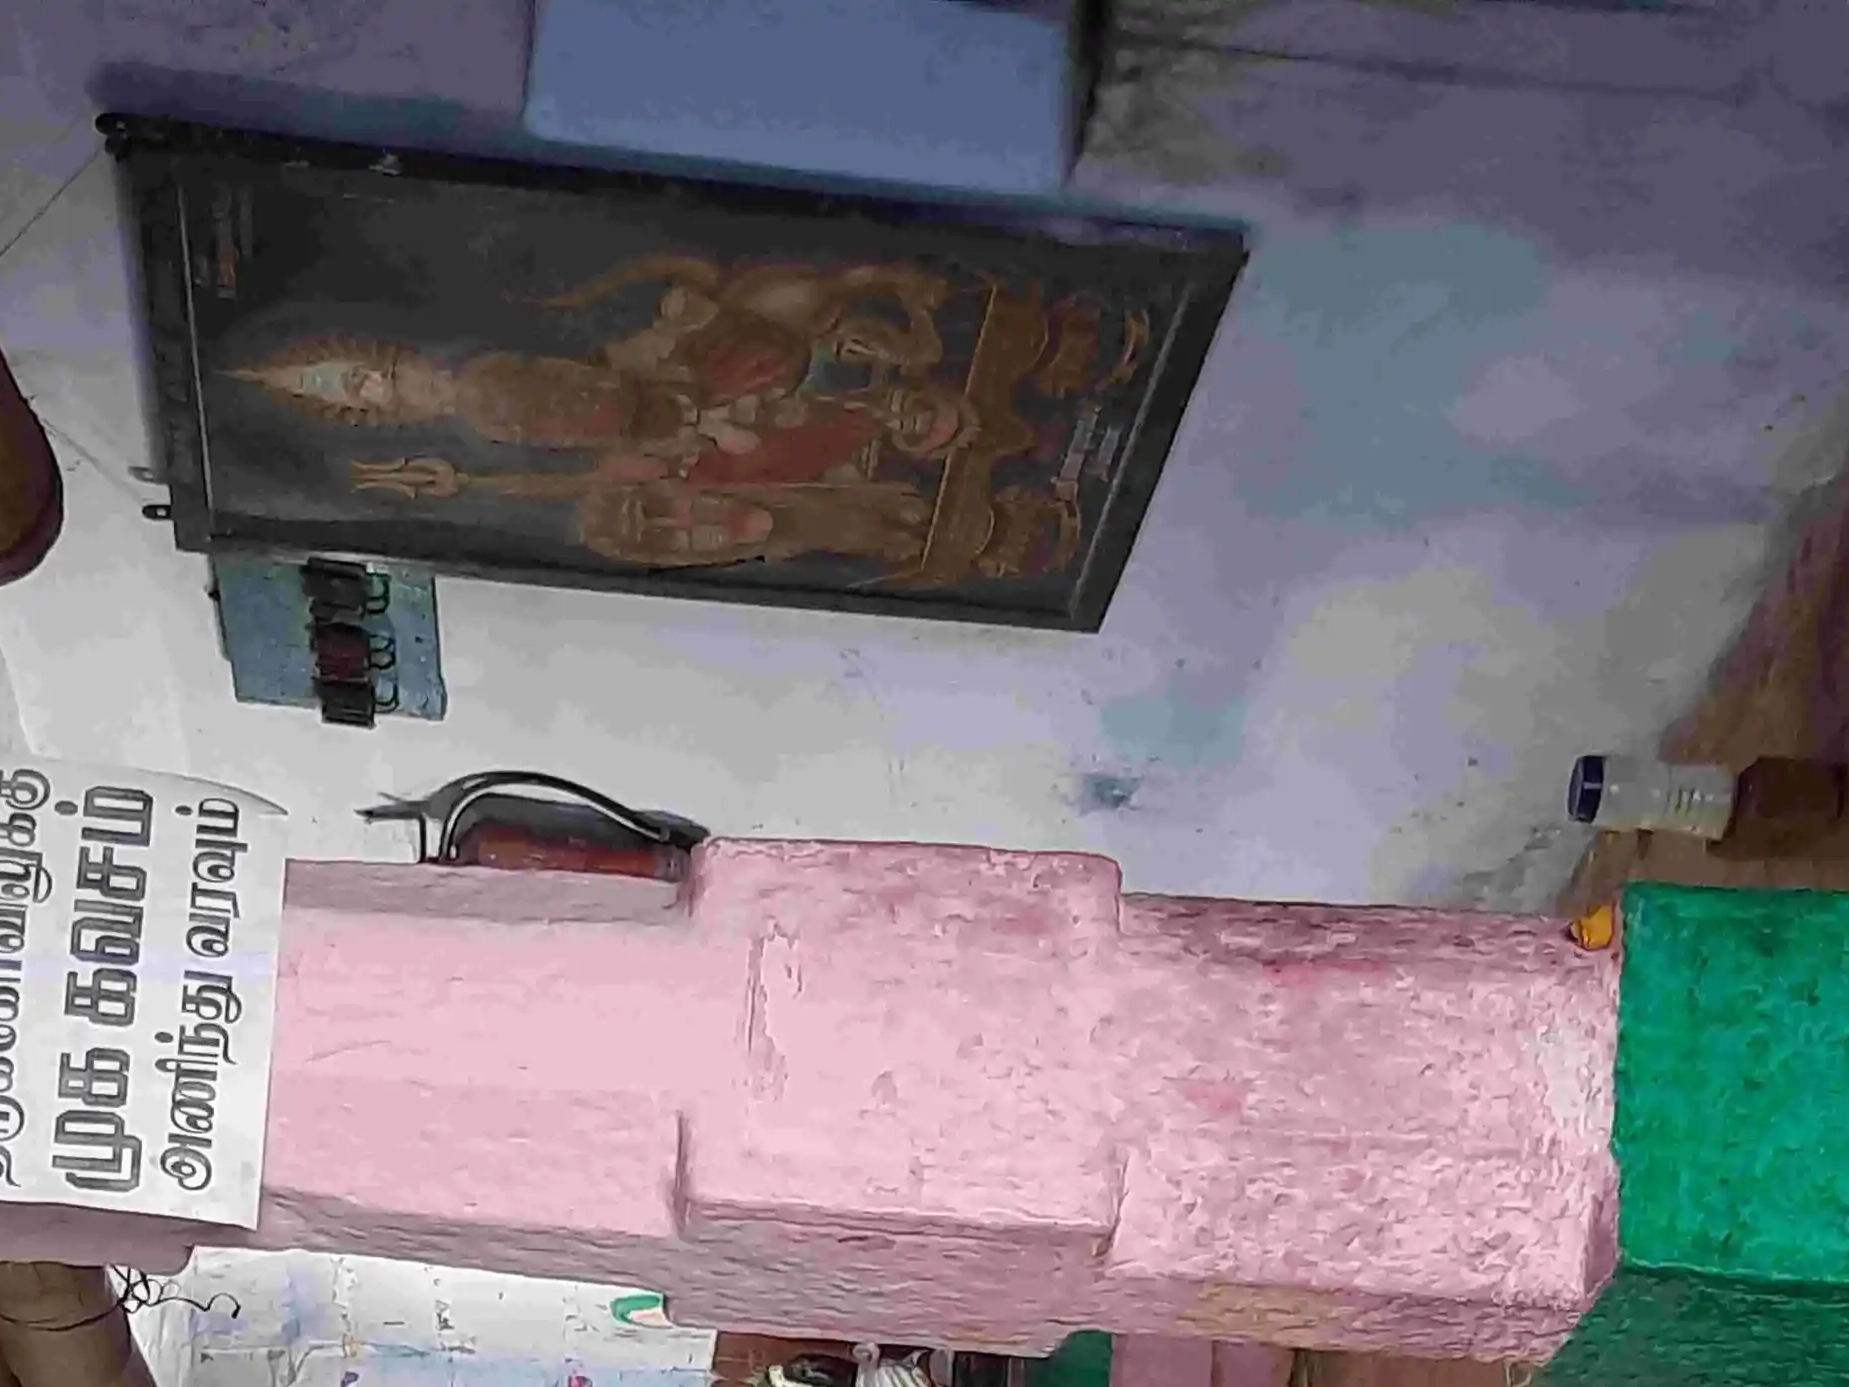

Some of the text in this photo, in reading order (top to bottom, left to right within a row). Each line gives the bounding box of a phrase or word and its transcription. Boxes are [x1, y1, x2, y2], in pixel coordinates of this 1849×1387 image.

[51, 785, 154, 1193] முக கவசம்
[154, 798, 248, 1192] அணிந்து வரவும்
